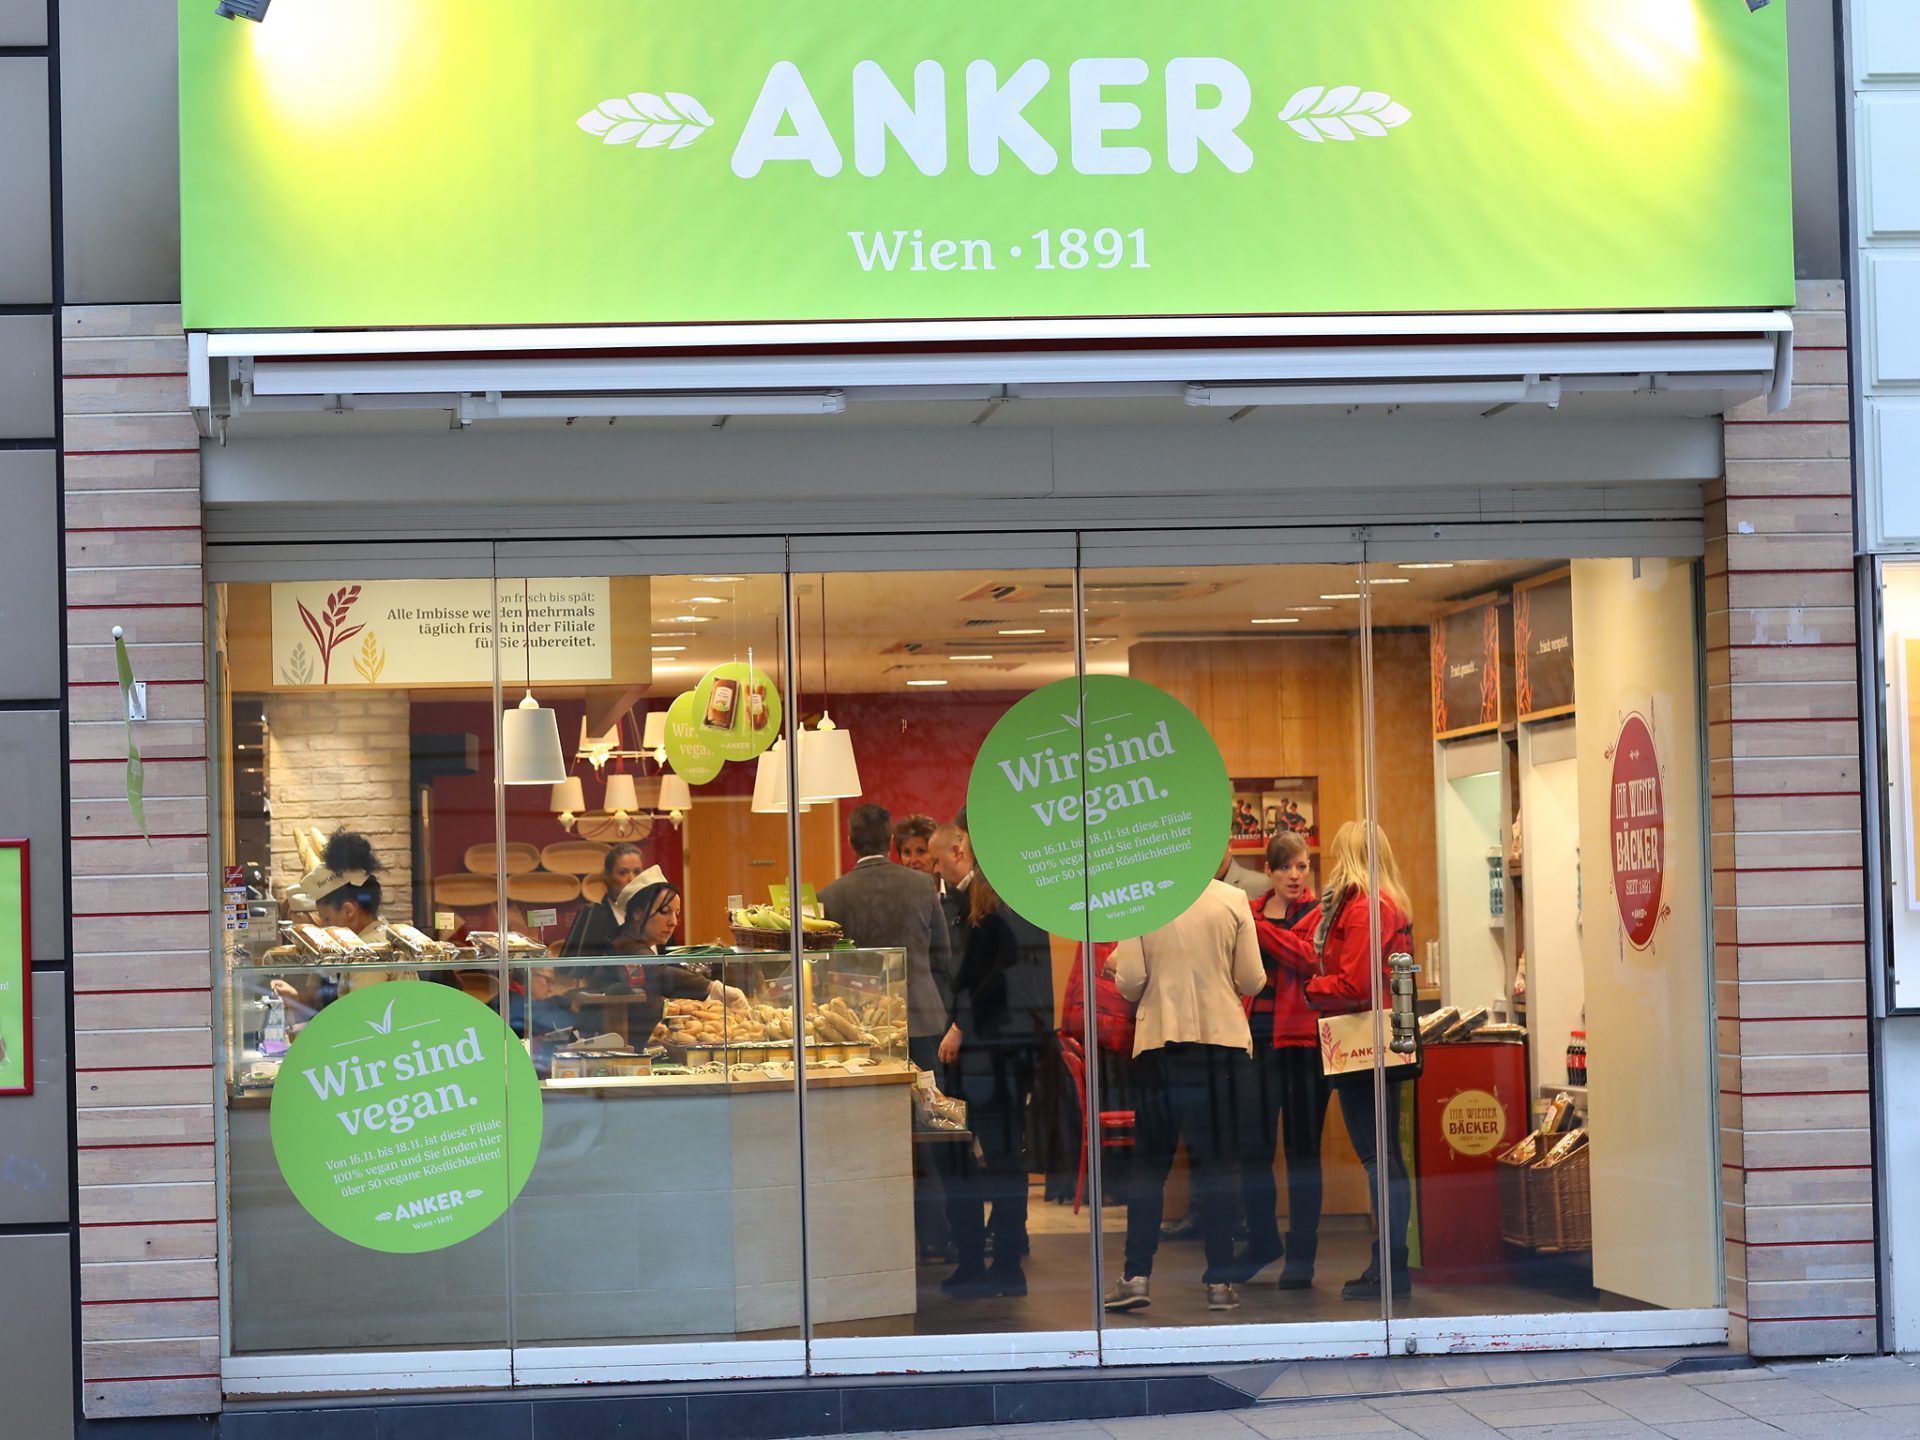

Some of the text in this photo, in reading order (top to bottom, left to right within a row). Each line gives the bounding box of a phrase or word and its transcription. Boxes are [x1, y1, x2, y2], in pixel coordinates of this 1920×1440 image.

[730, 56, 1255, 179] ANKER
[847, 227, 1151, 272] Wien 1891
[387, 605, 595, 620] Alle Imbisse weden mehrmals
[514, 592, 547, 603] frsch
[549, 592, 566, 602] bis
[567, 592, 595, 604] spät:
[418, 620, 596, 636] täglich frish in der Filiale
[500, 636, 520, 648] Sie
[522, 635, 596, 648] zubereitet.
[997, 719, 1176, 792] Wir sind
[1030, 775, 1169, 826] vegan.
[1615, 777, 1658, 819] IHR WIENER
[1020, 850, 1042, 861] Von
[1117, 825, 1130, 837] ist
[1132, 819, 1159, 834] diese
[1160, 810, 1192, 827] Filiale
[1028, 860, 1057, 874] 100%
[1093, 844, 1115, 857] und
[1116, 839, 1133, 852] Sie
[1134, 831, 1169, 848] finden
[1170, 825, 1192, 839] hier
[1615, 822, 1660, 873] BÄCKER
[1035, 872, 1060, 887] über
[1062, 868, 1075, 881] 50
[1115, 839, 1192, 867] Köstlichkeiten!
[1089, 880, 1156, 911] ANKER
[1105, 908, 1126, 920] Wien
[302, 1026, 485, 1101] Wir sind
[1351, 1046, 1387, 1058] ANKR
[336, 1083, 478, 1136] vegan.
[1449, 1119, 1499, 1135] BÄCKER
[1466, 1107, 1498, 1119] WIENER
[326, 1160, 347, 1171] Von
[377, 1147, 393, 1159] bis
[424, 1134, 438, 1146] ist
[440, 1128, 467, 1142] diese
[469, 1119, 502, 1134] Filiale
[332, 1133, 502, 1184] 100% vegan und Sie finden hier
[340, 1148, 502, 1197] über 50 vegane Köstlichkeiten!
[395, 1190, 464, 1221] ANKER
[411, 1219, 434, 1230] Wien
